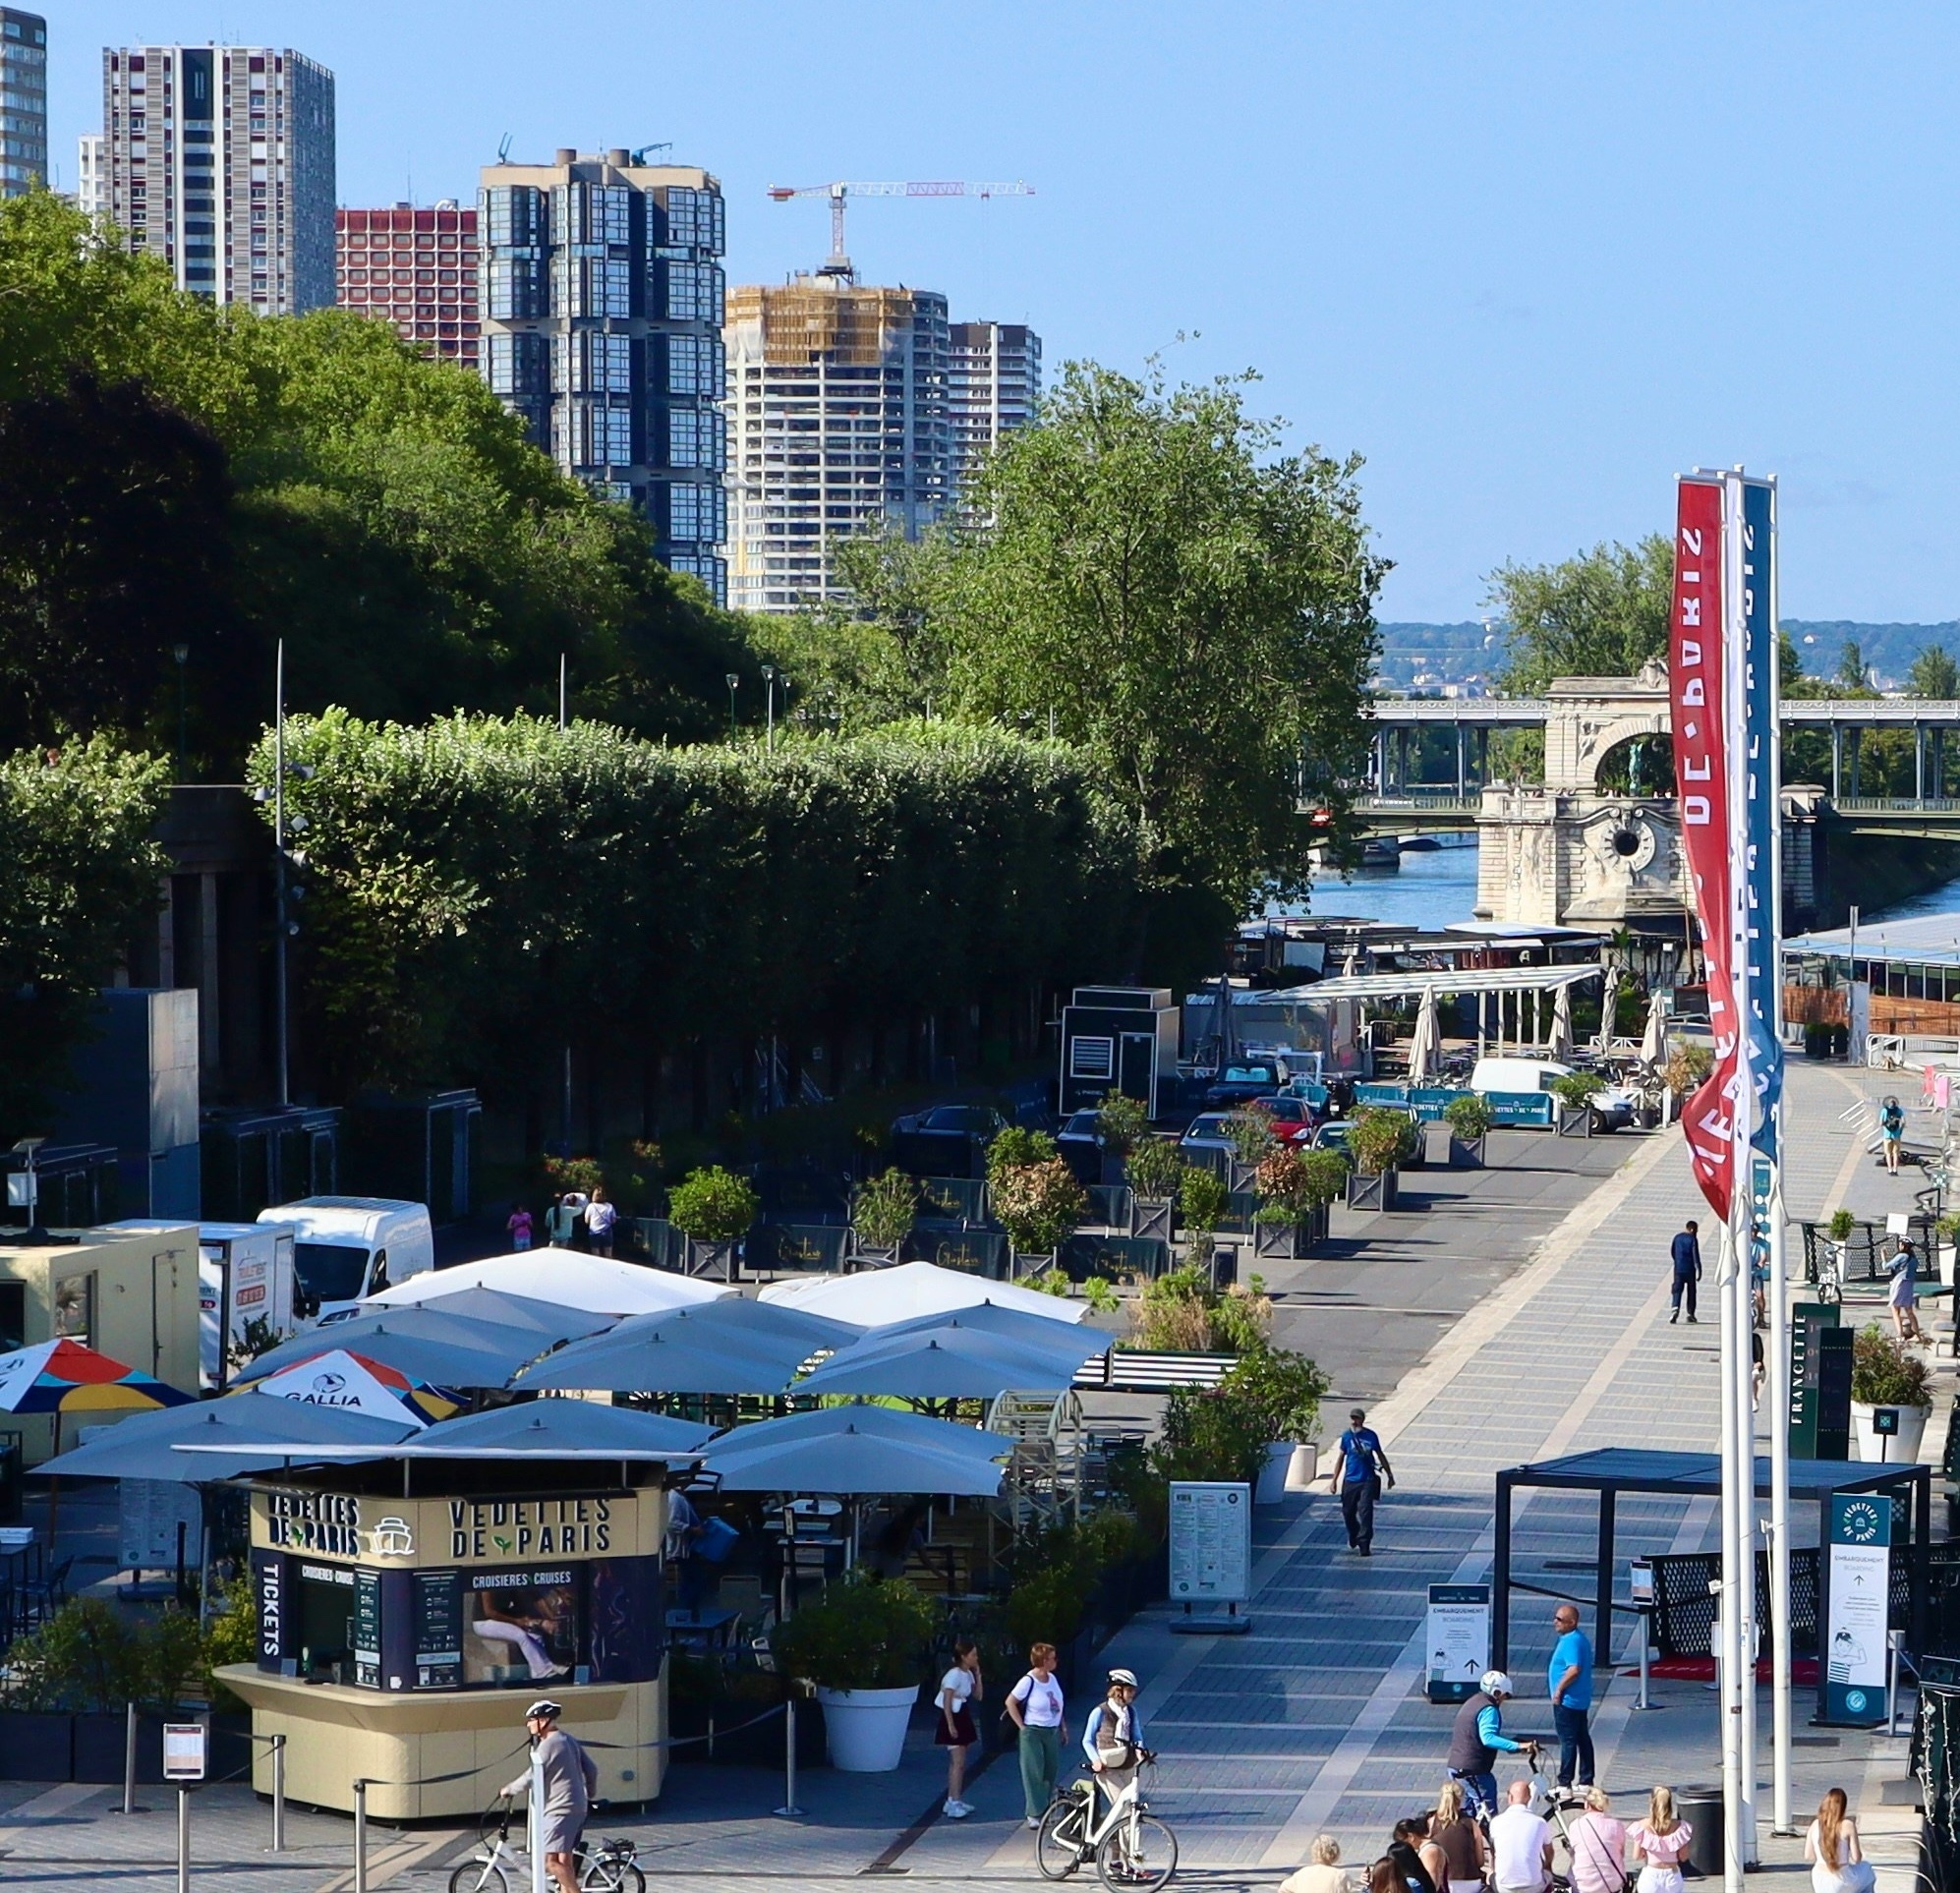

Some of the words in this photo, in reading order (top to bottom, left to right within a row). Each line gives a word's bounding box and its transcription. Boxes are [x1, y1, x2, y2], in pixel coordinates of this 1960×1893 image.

[1791, 1314, 1807, 1424] FRANCETTE
[448, 1499, 610, 1528] VEDETTES
[268, 1516, 292, 1545] DE
[304, 1520, 360, 1556] PARIS
[450, 1528, 487, 1558] DE
[516, 1523, 610, 1555] PARIS
[472, 1573, 528, 1588] CROISIERES
[534, 1571, 571, 1585] CRUISES
[262, 1564, 280, 1656] TICKETS
